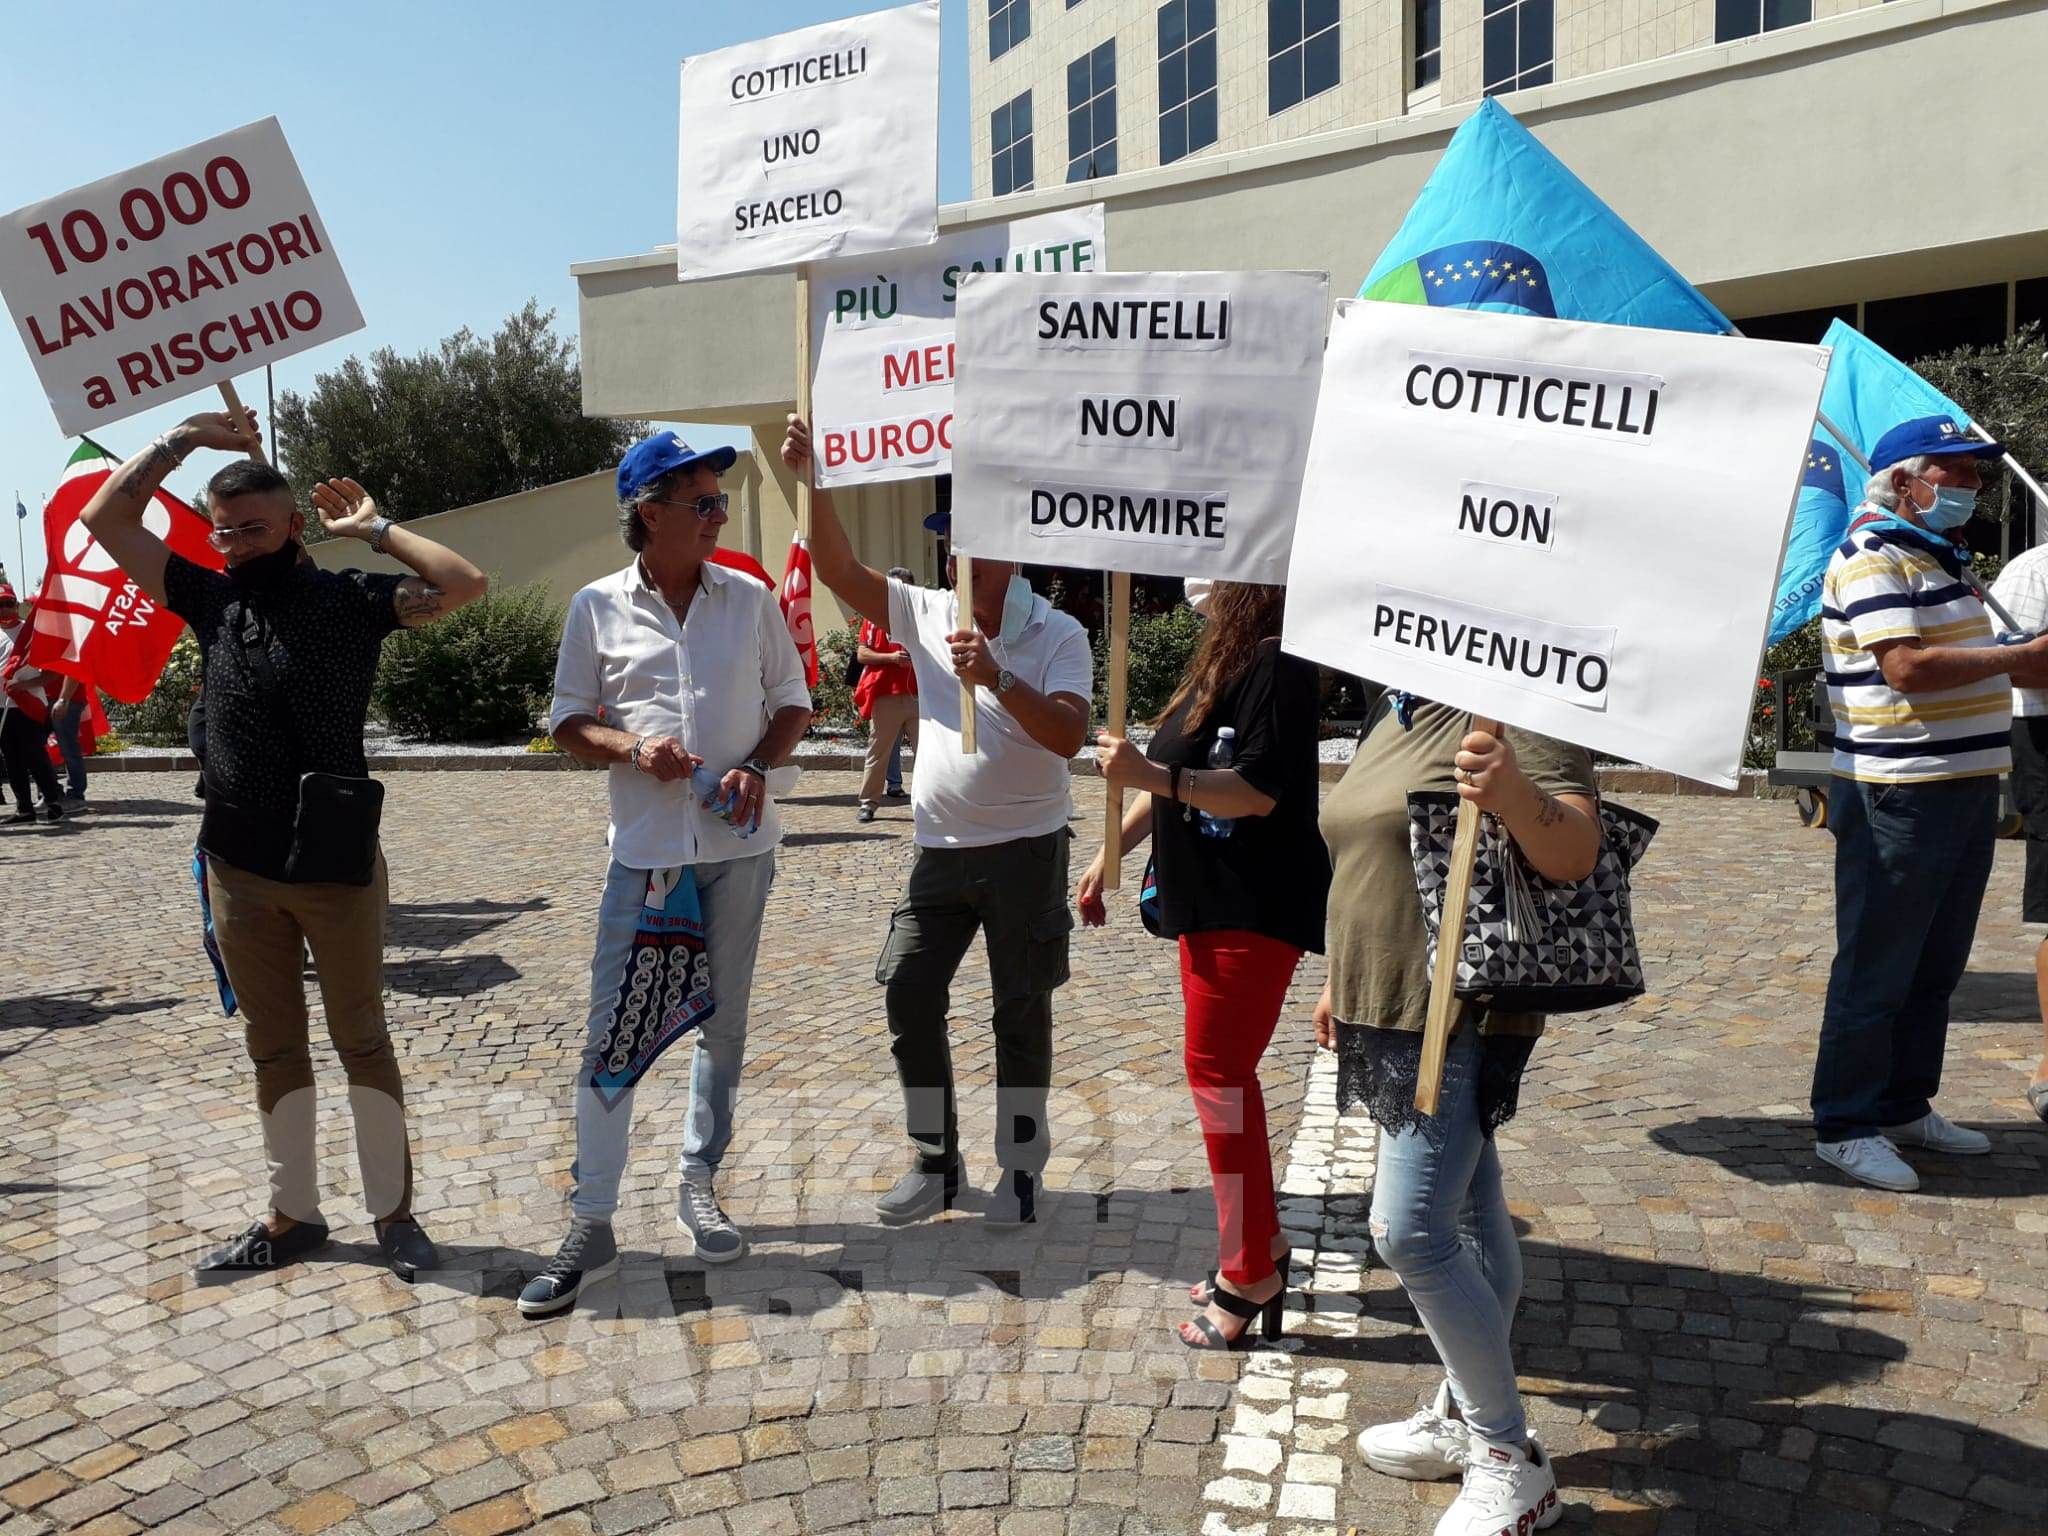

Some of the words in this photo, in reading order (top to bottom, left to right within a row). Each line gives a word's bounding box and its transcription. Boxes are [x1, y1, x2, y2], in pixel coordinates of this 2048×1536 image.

[731, 47, 866, 99] COTTICELLI
[763, 128, 820, 163] UNO
[27, 156, 251, 275] 10.000
[735, 189, 843, 231] SFACELO
[25, 214, 323, 356] LAVORATORI
[836, 275, 898, 323] PIÙ
[1037, 300, 1228, 340] SANTELLI
[82, 374, 117, 410] a
[117, 290, 322, 396] RISCHIO
[1081, 399, 1175, 437] NON
[1405, 363, 1659, 435] COTTICELLI
[1030, 489, 1226, 538] DORMIRE
[1458, 494, 1552, 544] NON
[1373, 605, 1609, 693] PERVENUTO
